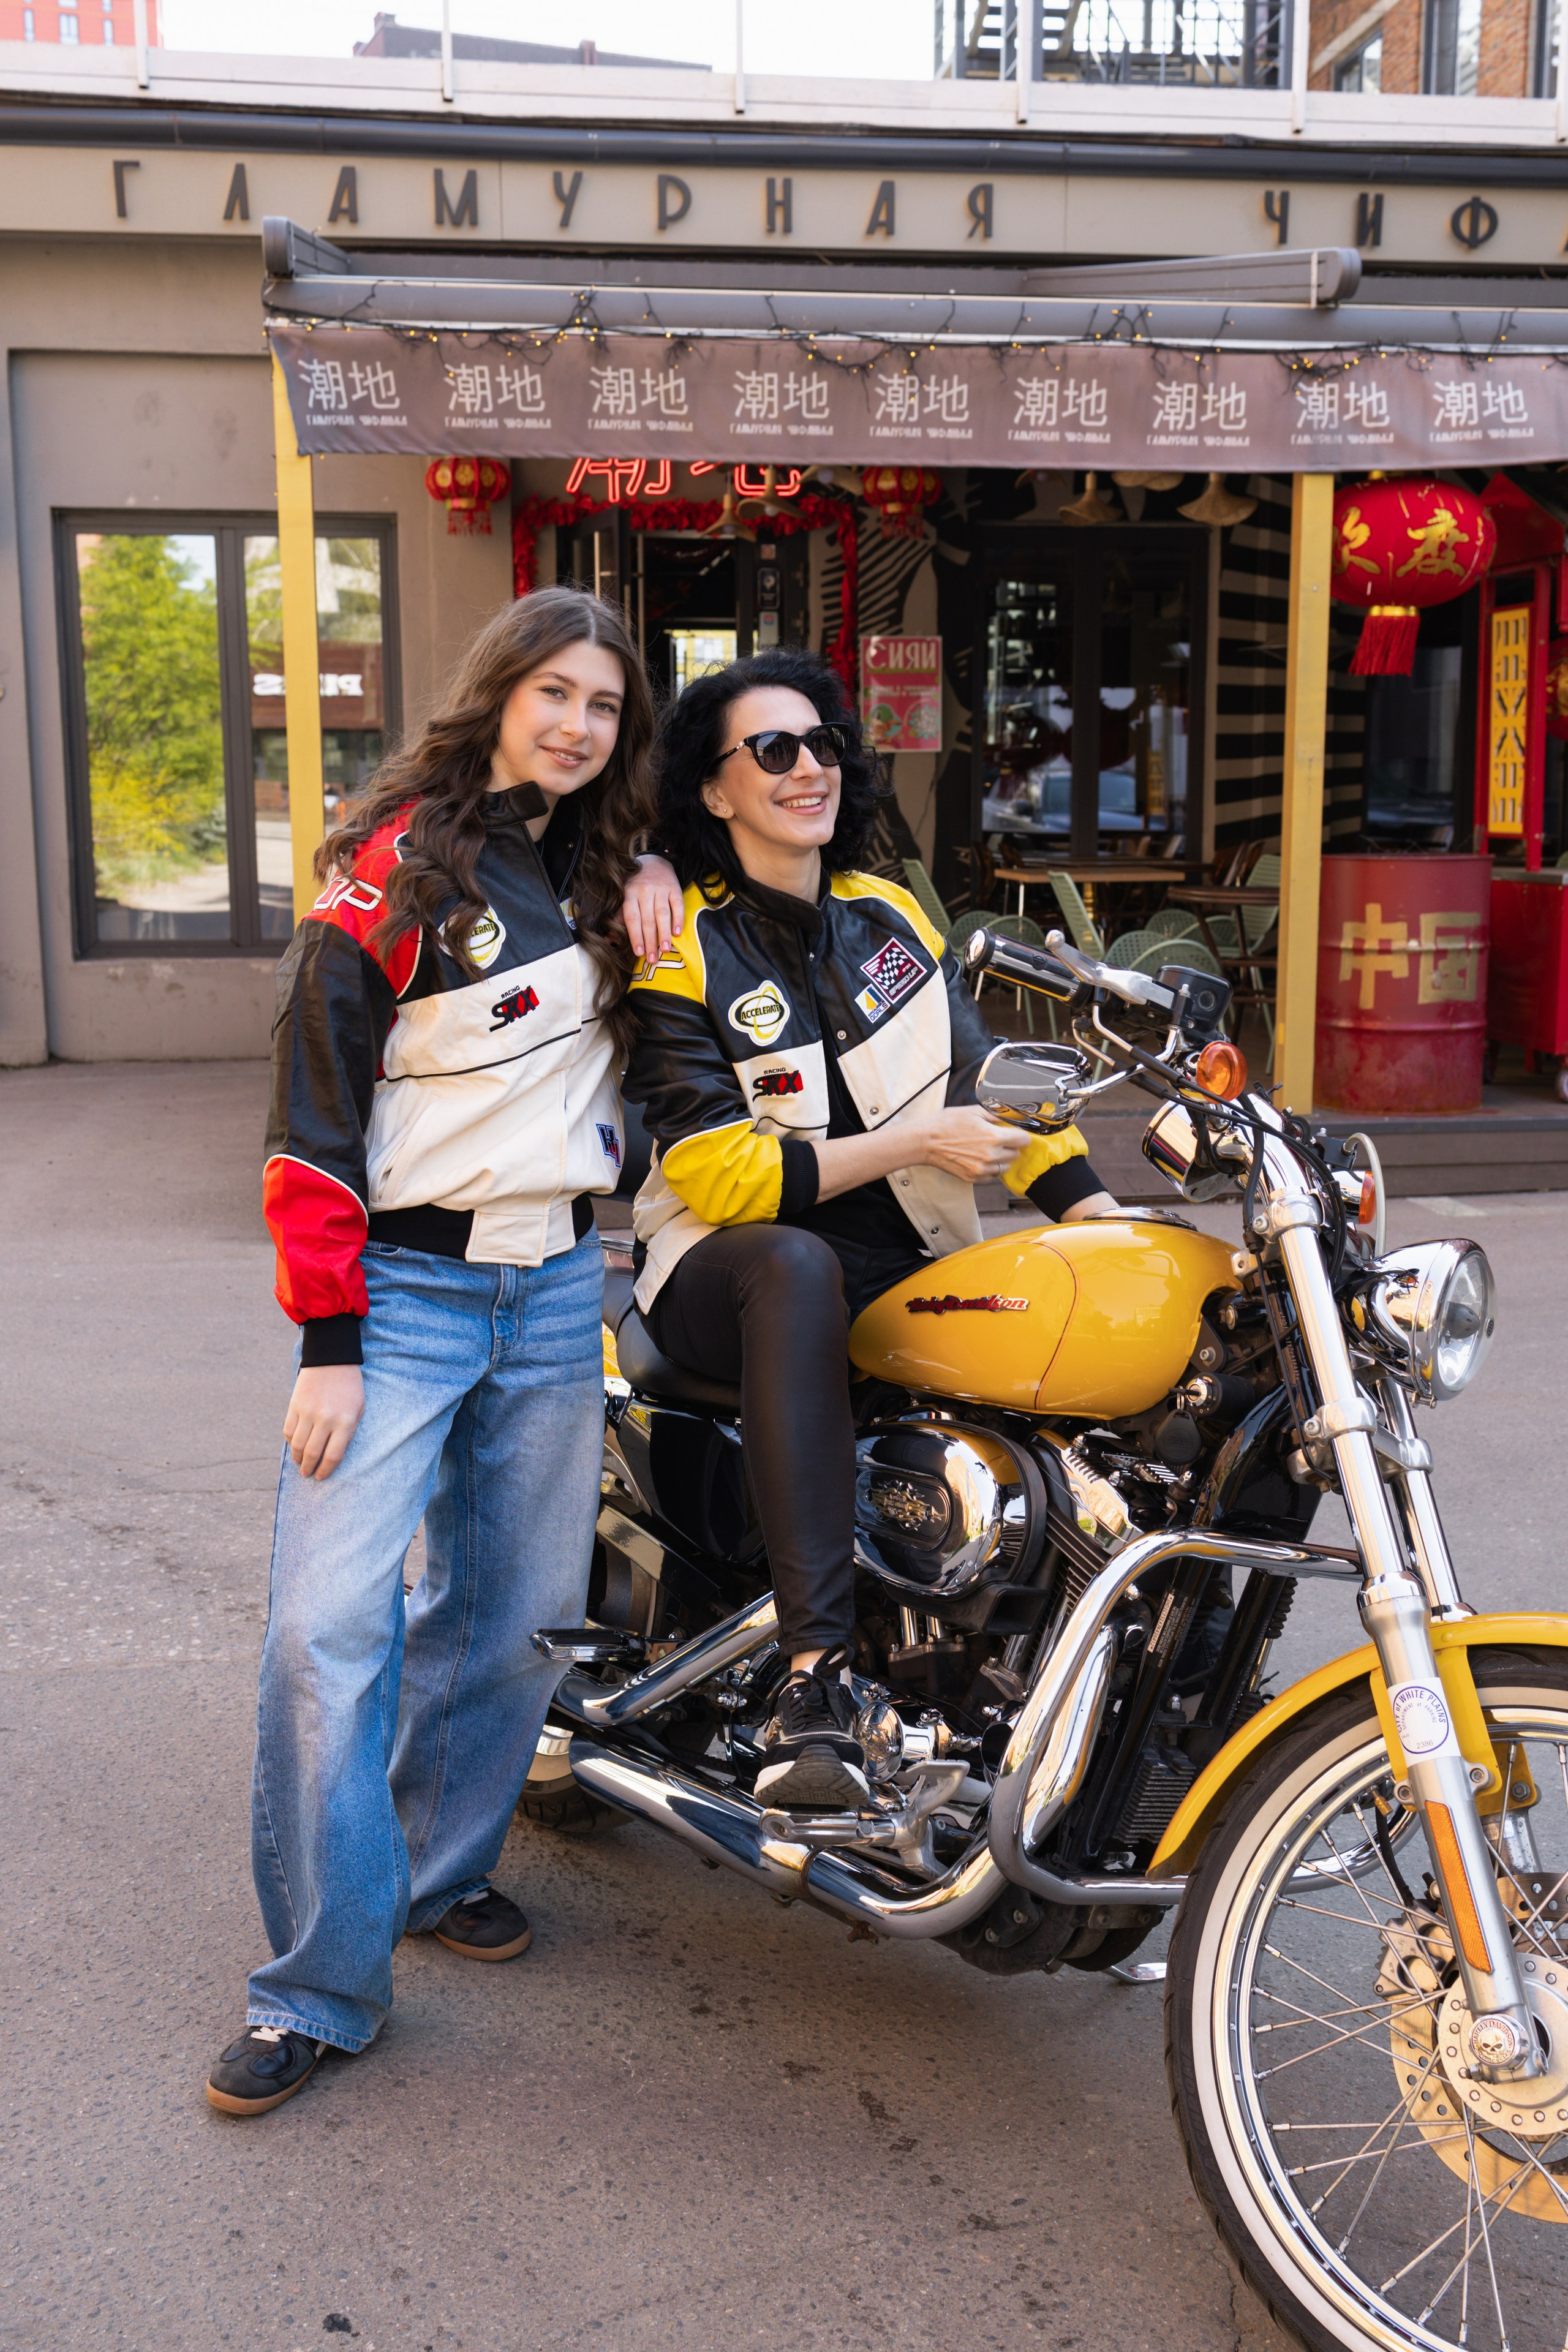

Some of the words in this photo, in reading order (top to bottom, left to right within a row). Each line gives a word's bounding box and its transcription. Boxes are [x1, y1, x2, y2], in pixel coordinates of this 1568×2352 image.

[113, 160, 993, 238] ГЛАМУРНАЯ
[1263, 190, 1568, 252] ЧИФ
[298, 358, 400, 411] 潮地
[443, 363, 546, 413] 潮地
[589, 366, 688, 415] 潮地
[733, 370, 831, 420] 潮地
[875, 373, 970, 423] 潮地
[1014, 377, 1108, 426] 潮地
[1152, 380, 1247, 431] 潮地
[1296, 380, 1390, 430] 潮地
[1433, 380, 1528, 428] 潮地
[865, 639, 937, 670] СИЯЙ
[1339, 902, 1481, 1010] 中国
[501, 986, 520, 1000] RACING
[741, 1003, 781, 1021] ACCELERATE
[870, 1003, 888, 1021] GOALS
[1399, 1690, 1424, 1703] WHITE
[1427, 1694, 1446, 1723] PLAINS
[1416, 1740, 1433, 1749] 2386
